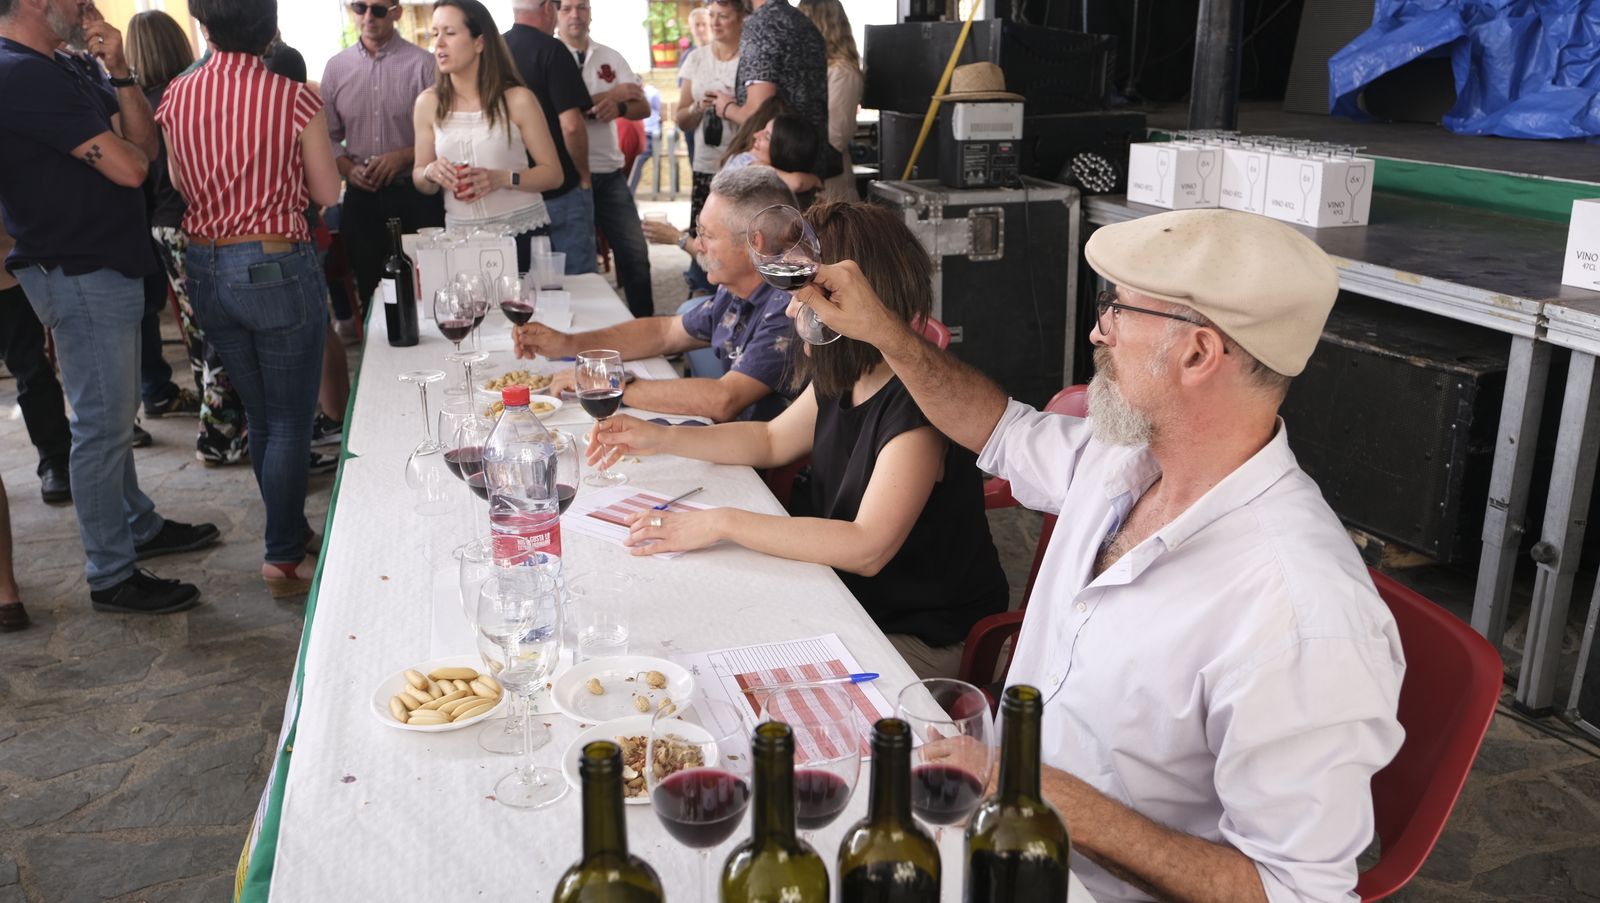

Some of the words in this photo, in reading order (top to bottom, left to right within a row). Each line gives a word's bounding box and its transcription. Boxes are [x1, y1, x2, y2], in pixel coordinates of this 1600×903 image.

[1181, 182, 1197, 190] VINO
[1327, 199, 1345, 208] VINO
[1576, 250, 1599, 262] VINO
[486, 260, 498, 269] 6x
[1582, 262, 1596, 272] 47CL
